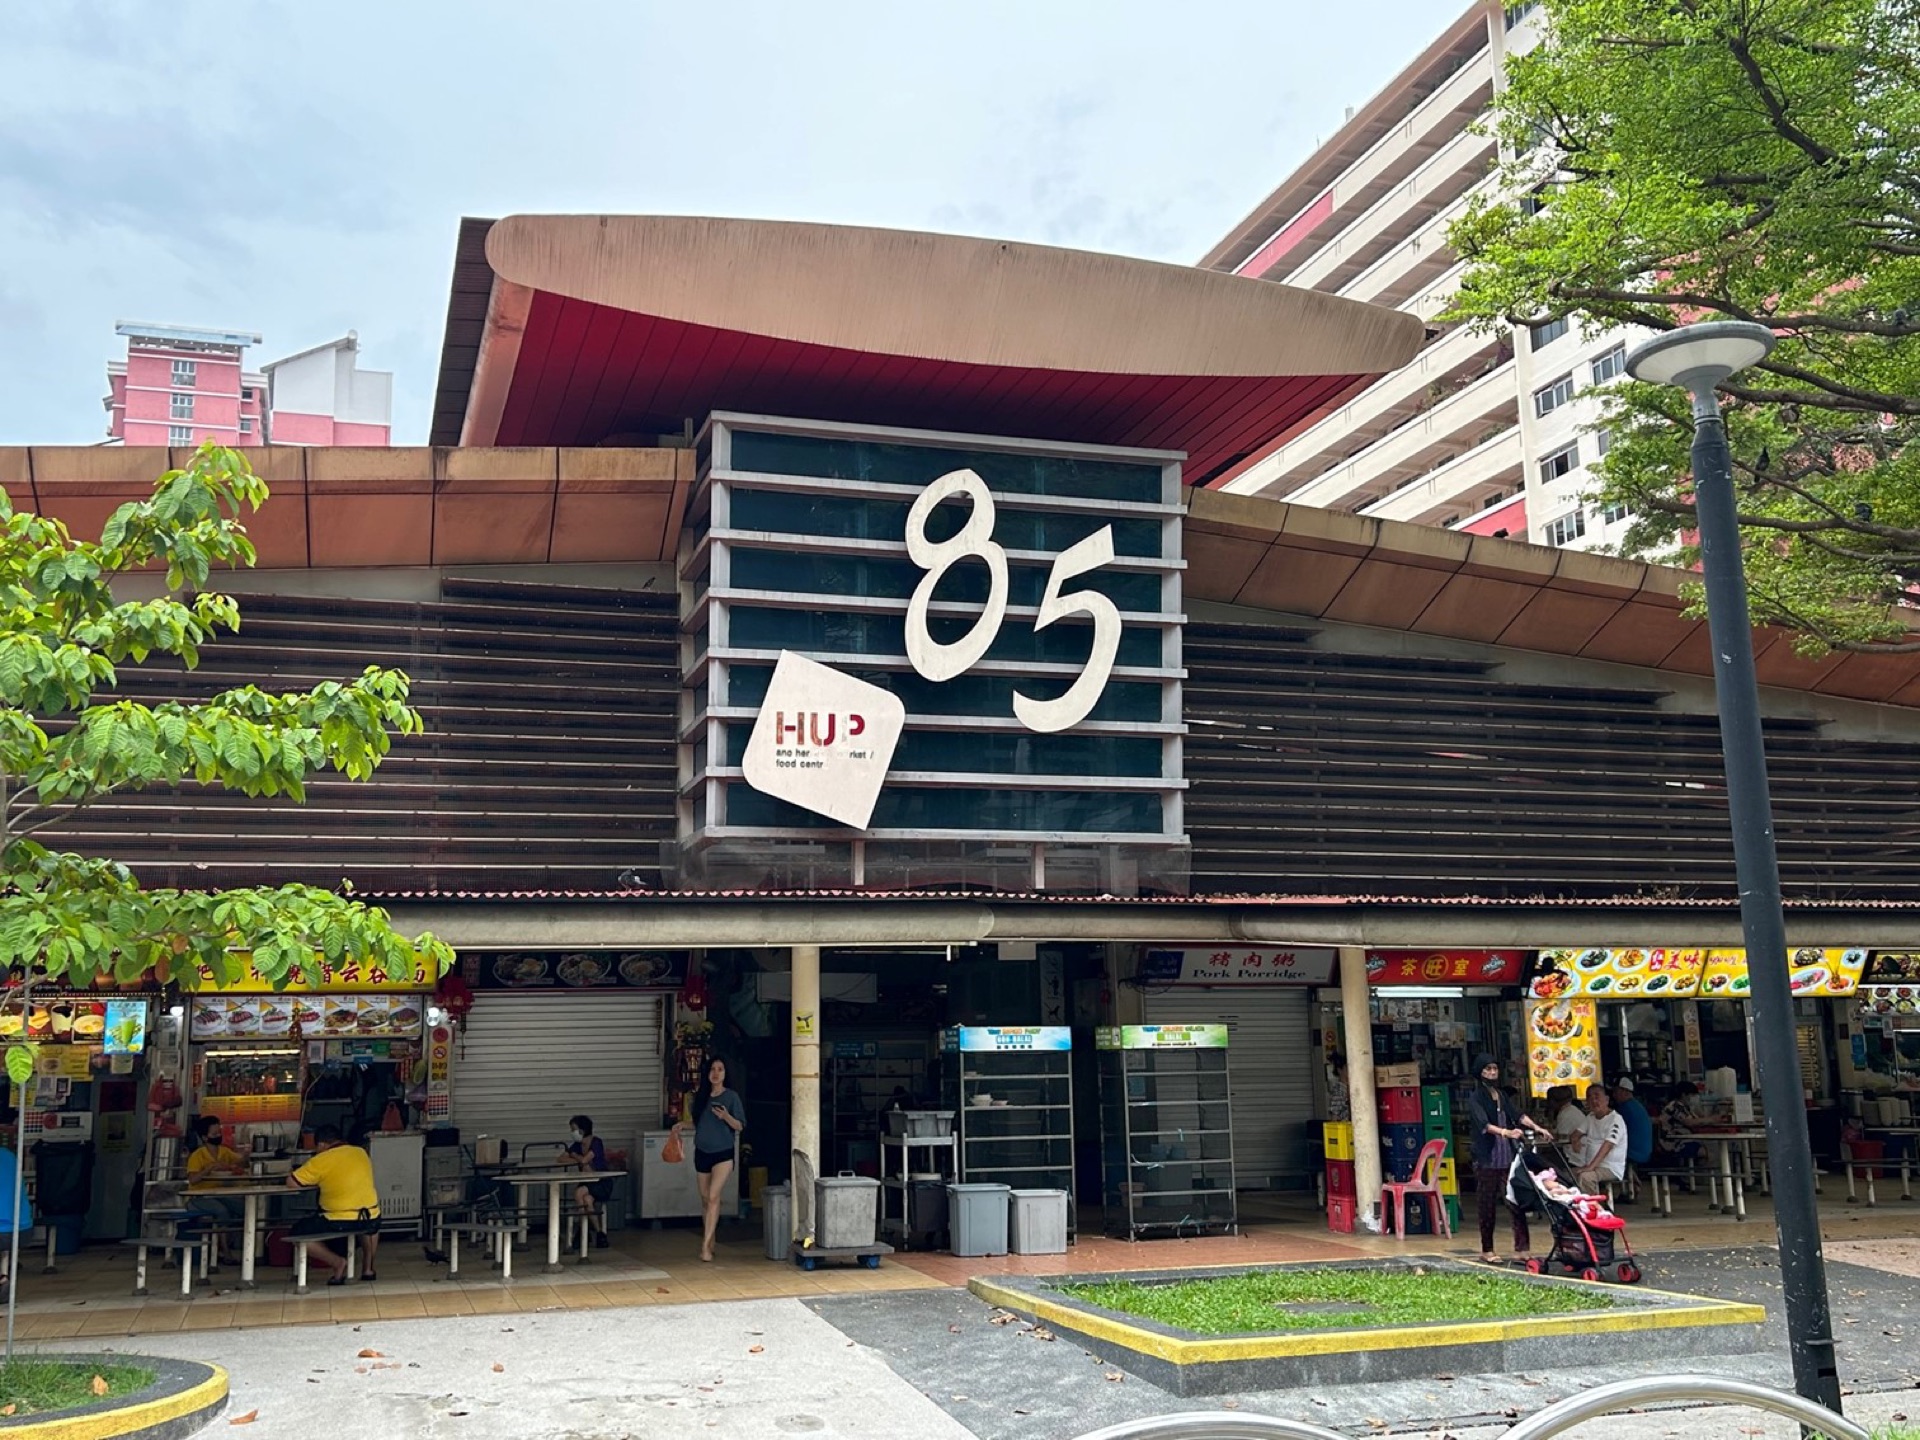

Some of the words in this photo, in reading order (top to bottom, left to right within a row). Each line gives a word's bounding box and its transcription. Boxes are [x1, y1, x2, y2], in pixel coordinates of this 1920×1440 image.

[905, 468, 1122, 733] 85
[776, 760, 797, 768] food
[1193, 969, 1230, 979] Pork
[1237, 969, 1306, 980] Porridge
